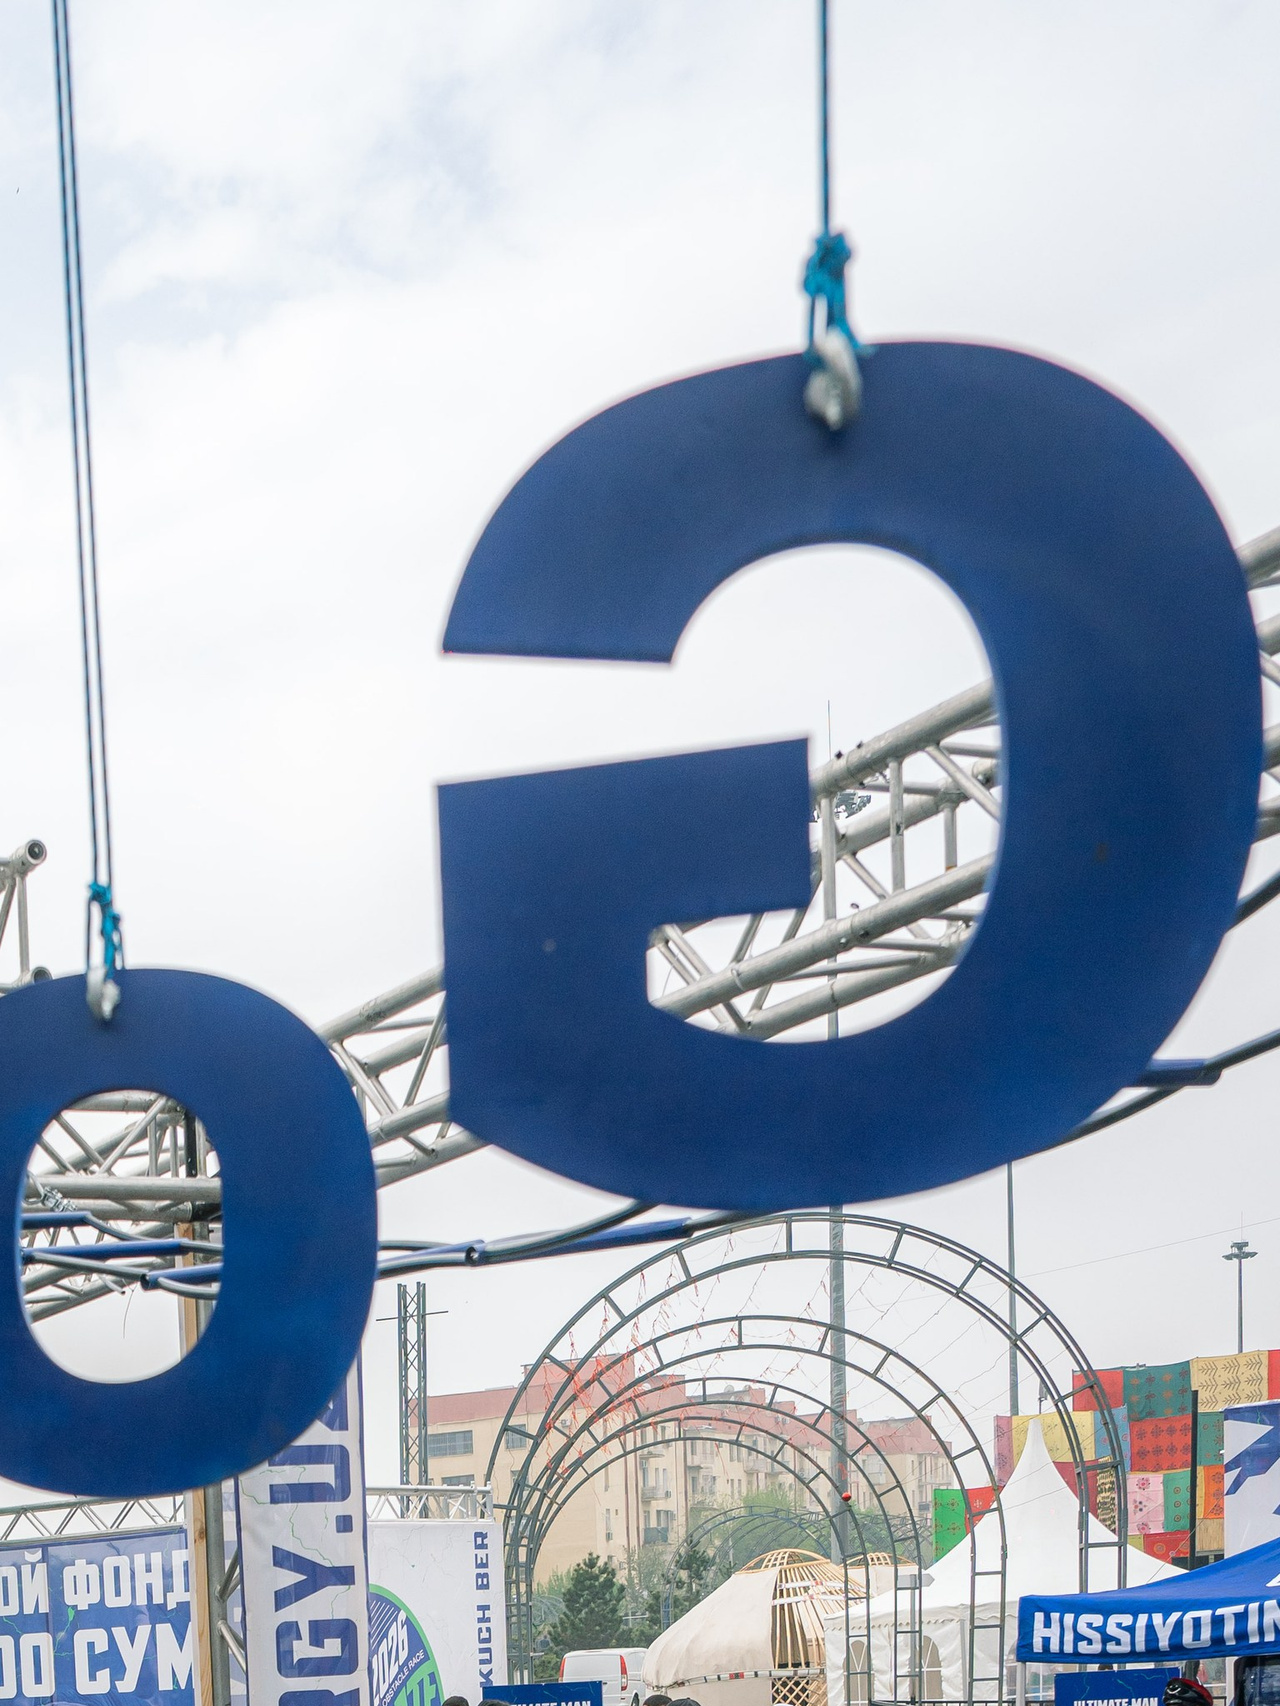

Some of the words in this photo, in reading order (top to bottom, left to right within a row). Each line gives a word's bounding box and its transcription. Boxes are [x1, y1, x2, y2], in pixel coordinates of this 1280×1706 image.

[473, 1531, 490, 1591] BER
[73, 1621, 195, 1696] СУМ
[408, 1649, 425, 1671] RACE
[477, 1604, 494, 1688] KUCH
